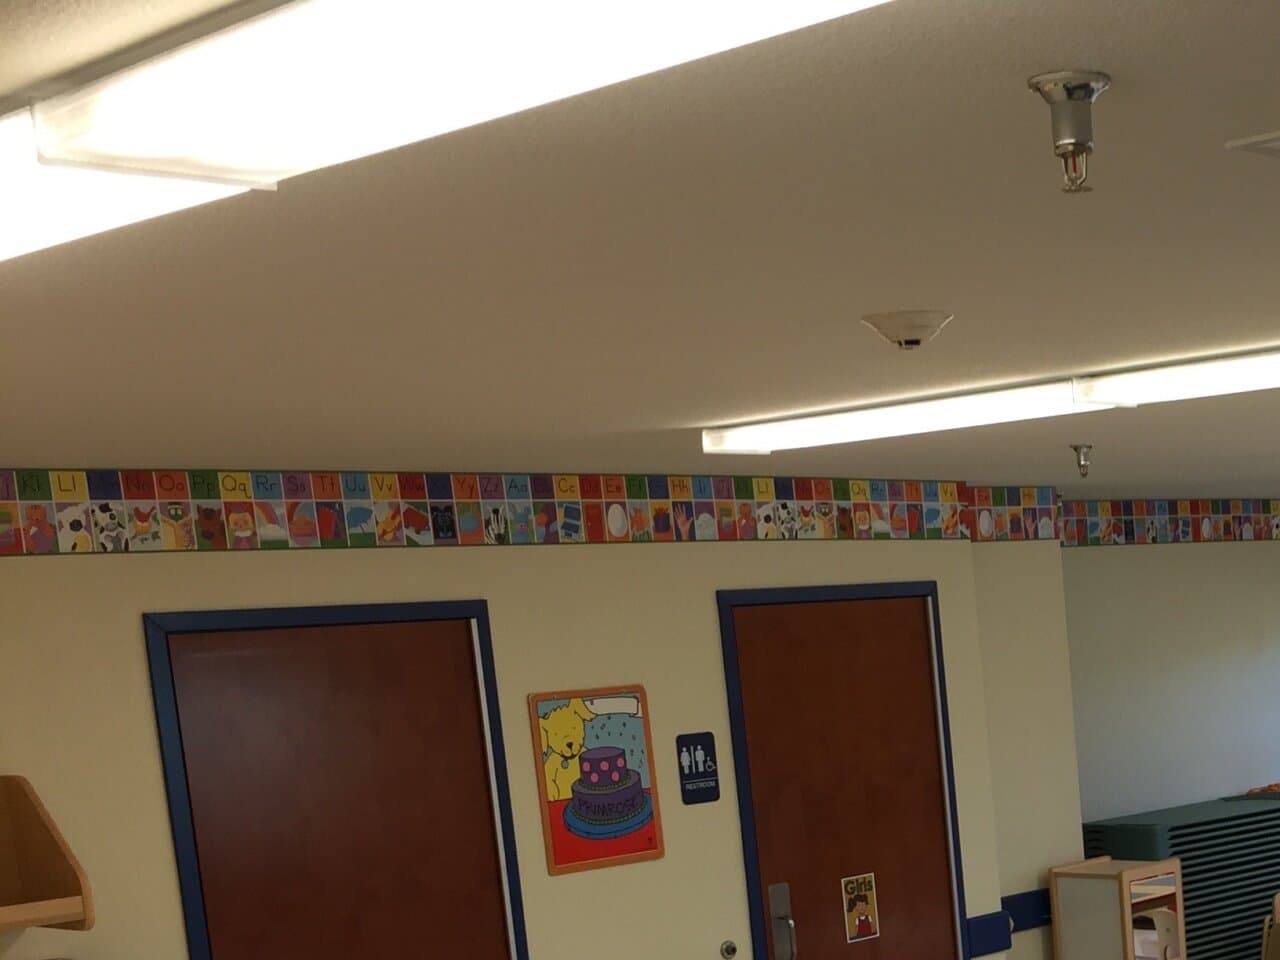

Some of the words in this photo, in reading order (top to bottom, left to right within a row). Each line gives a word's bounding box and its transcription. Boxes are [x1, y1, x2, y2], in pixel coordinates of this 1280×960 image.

[159, 475, 185, 492] Oo
[222, 475, 252, 499] Qq
[374, 477, 393, 493] Vv
[685, 781, 716, 790] RESTROOM
[577, 798, 638, 817] PRIMROSE
[844, 877, 873, 895] Girls
